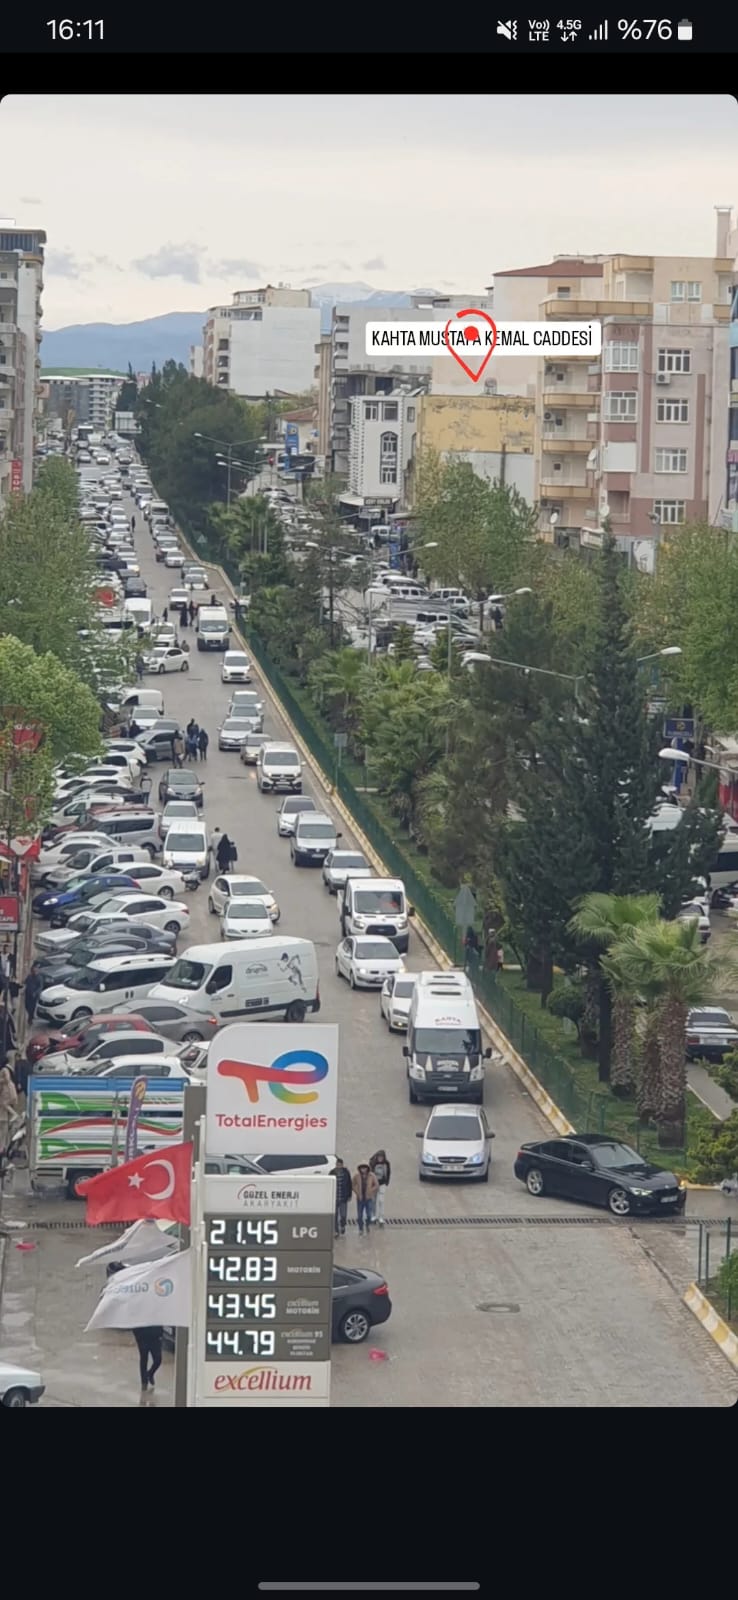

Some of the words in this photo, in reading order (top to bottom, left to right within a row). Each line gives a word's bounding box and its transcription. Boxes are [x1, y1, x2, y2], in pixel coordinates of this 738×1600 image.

[215, 1113, 328, 1131] TotalEnergies
[243, 1190, 268, 1199] GÜZEL
[210, 1219, 279, 1245] 21.45
[291, 1226, 319, 1239] LPG
[209, 1256, 278, 1282] 42.83
[208, 1293, 276, 1319] 43.45
[206, 1330, 276, 1356] 44.79
[214, 1371, 312, 1391] excellium
